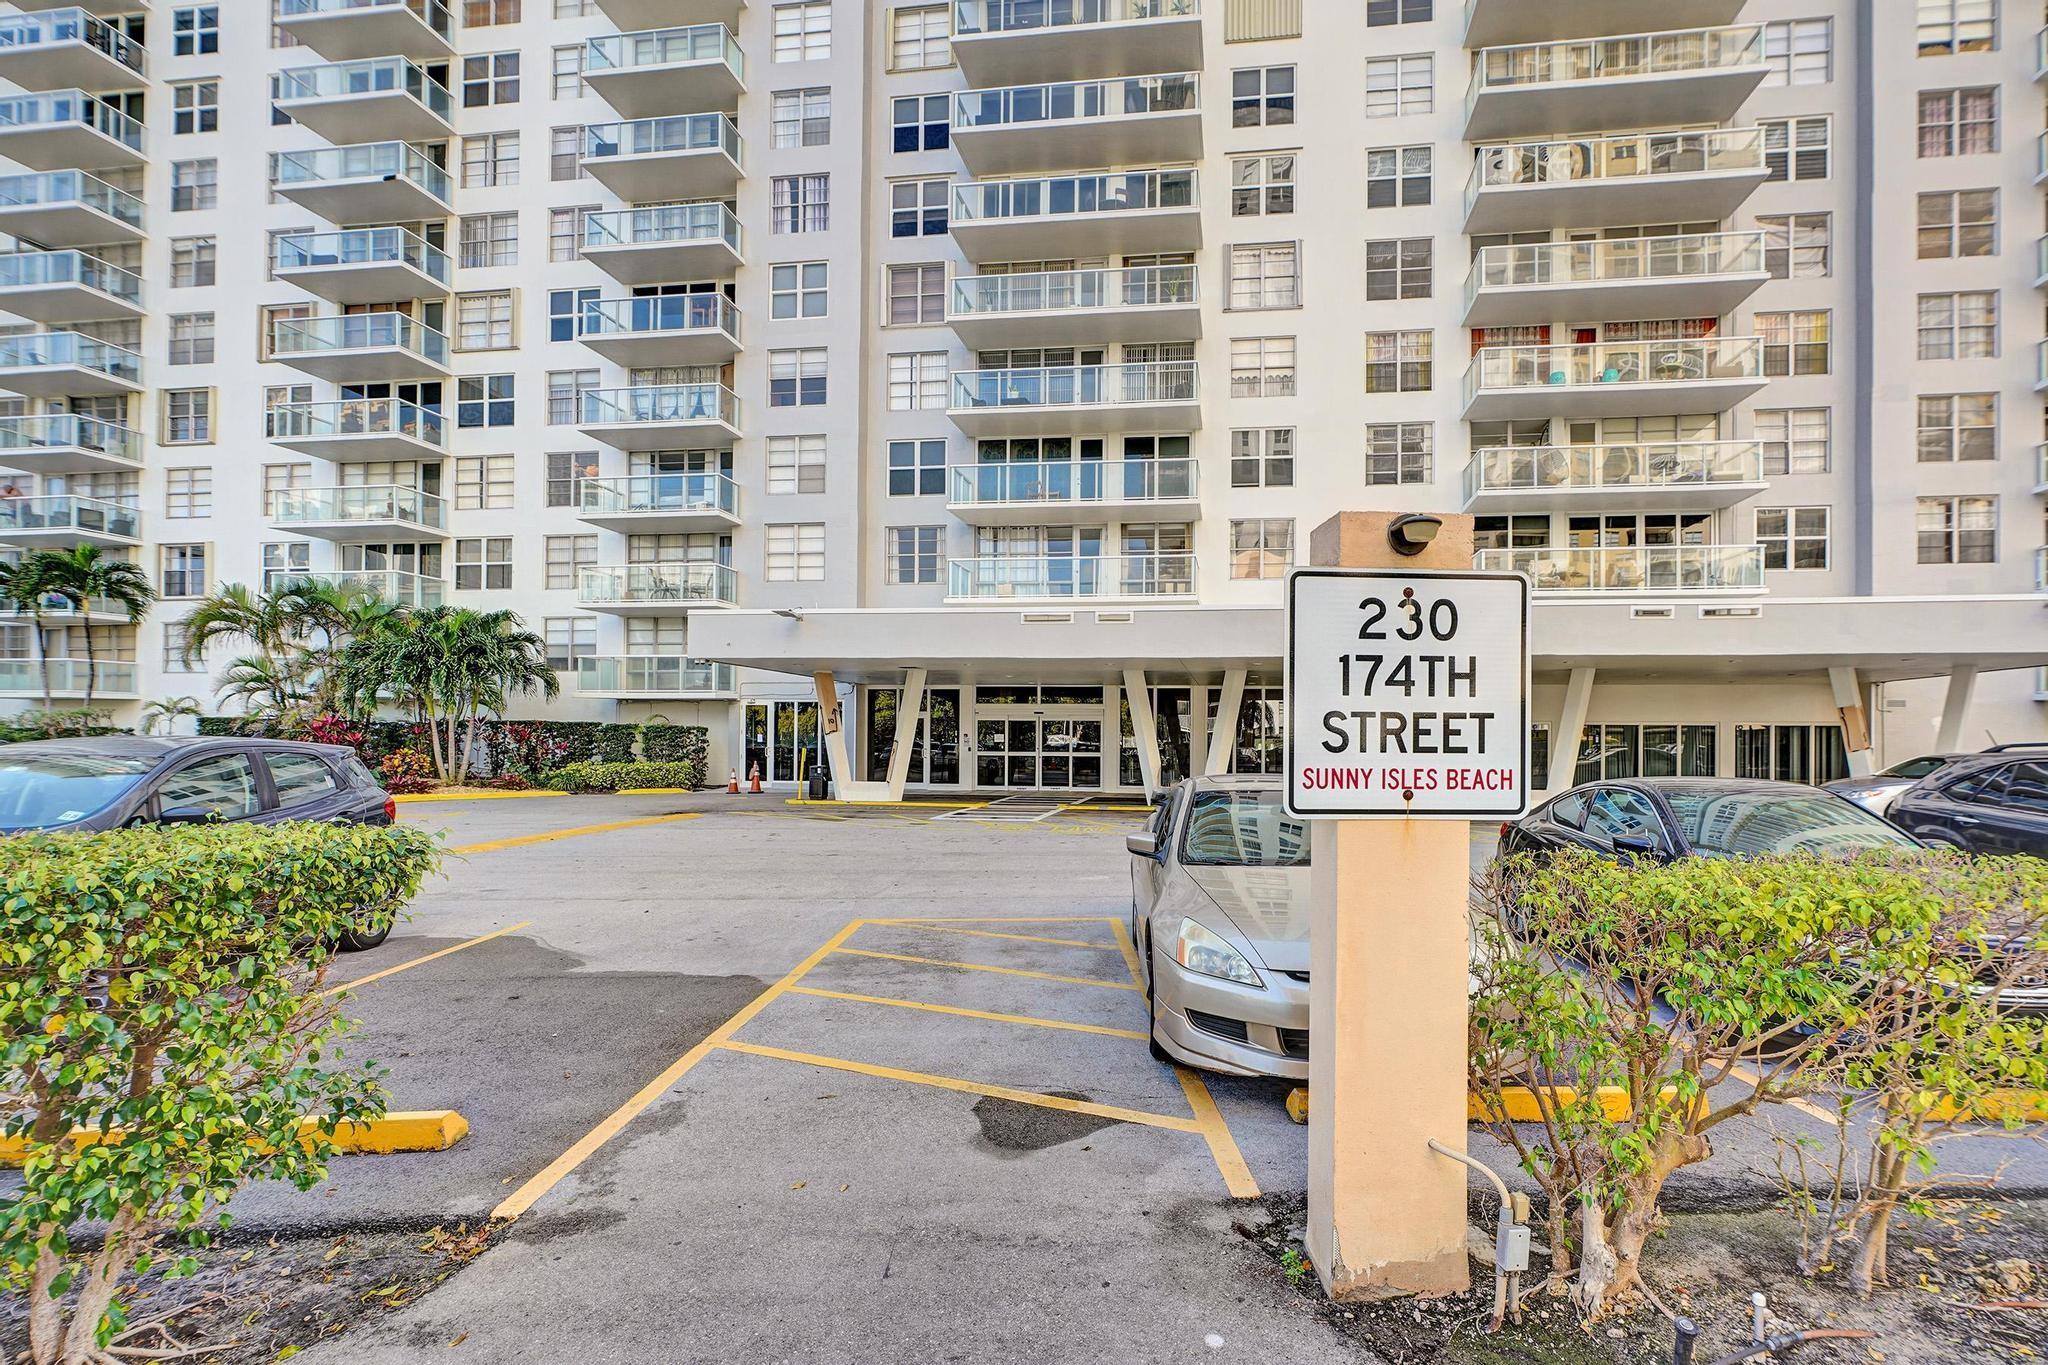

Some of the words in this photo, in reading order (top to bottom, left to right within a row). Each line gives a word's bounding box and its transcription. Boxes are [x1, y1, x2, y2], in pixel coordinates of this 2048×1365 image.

[1358, 597, 1458, 641] 230
[1339, 654, 1477, 698] 174TH
[1321, 711, 1495, 754] STREET
[1302, 767, 1373, 790] SUNNY
[1381, 768, 1438, 790] ISLES
[1446, 768, 1513, 790] BEACH
